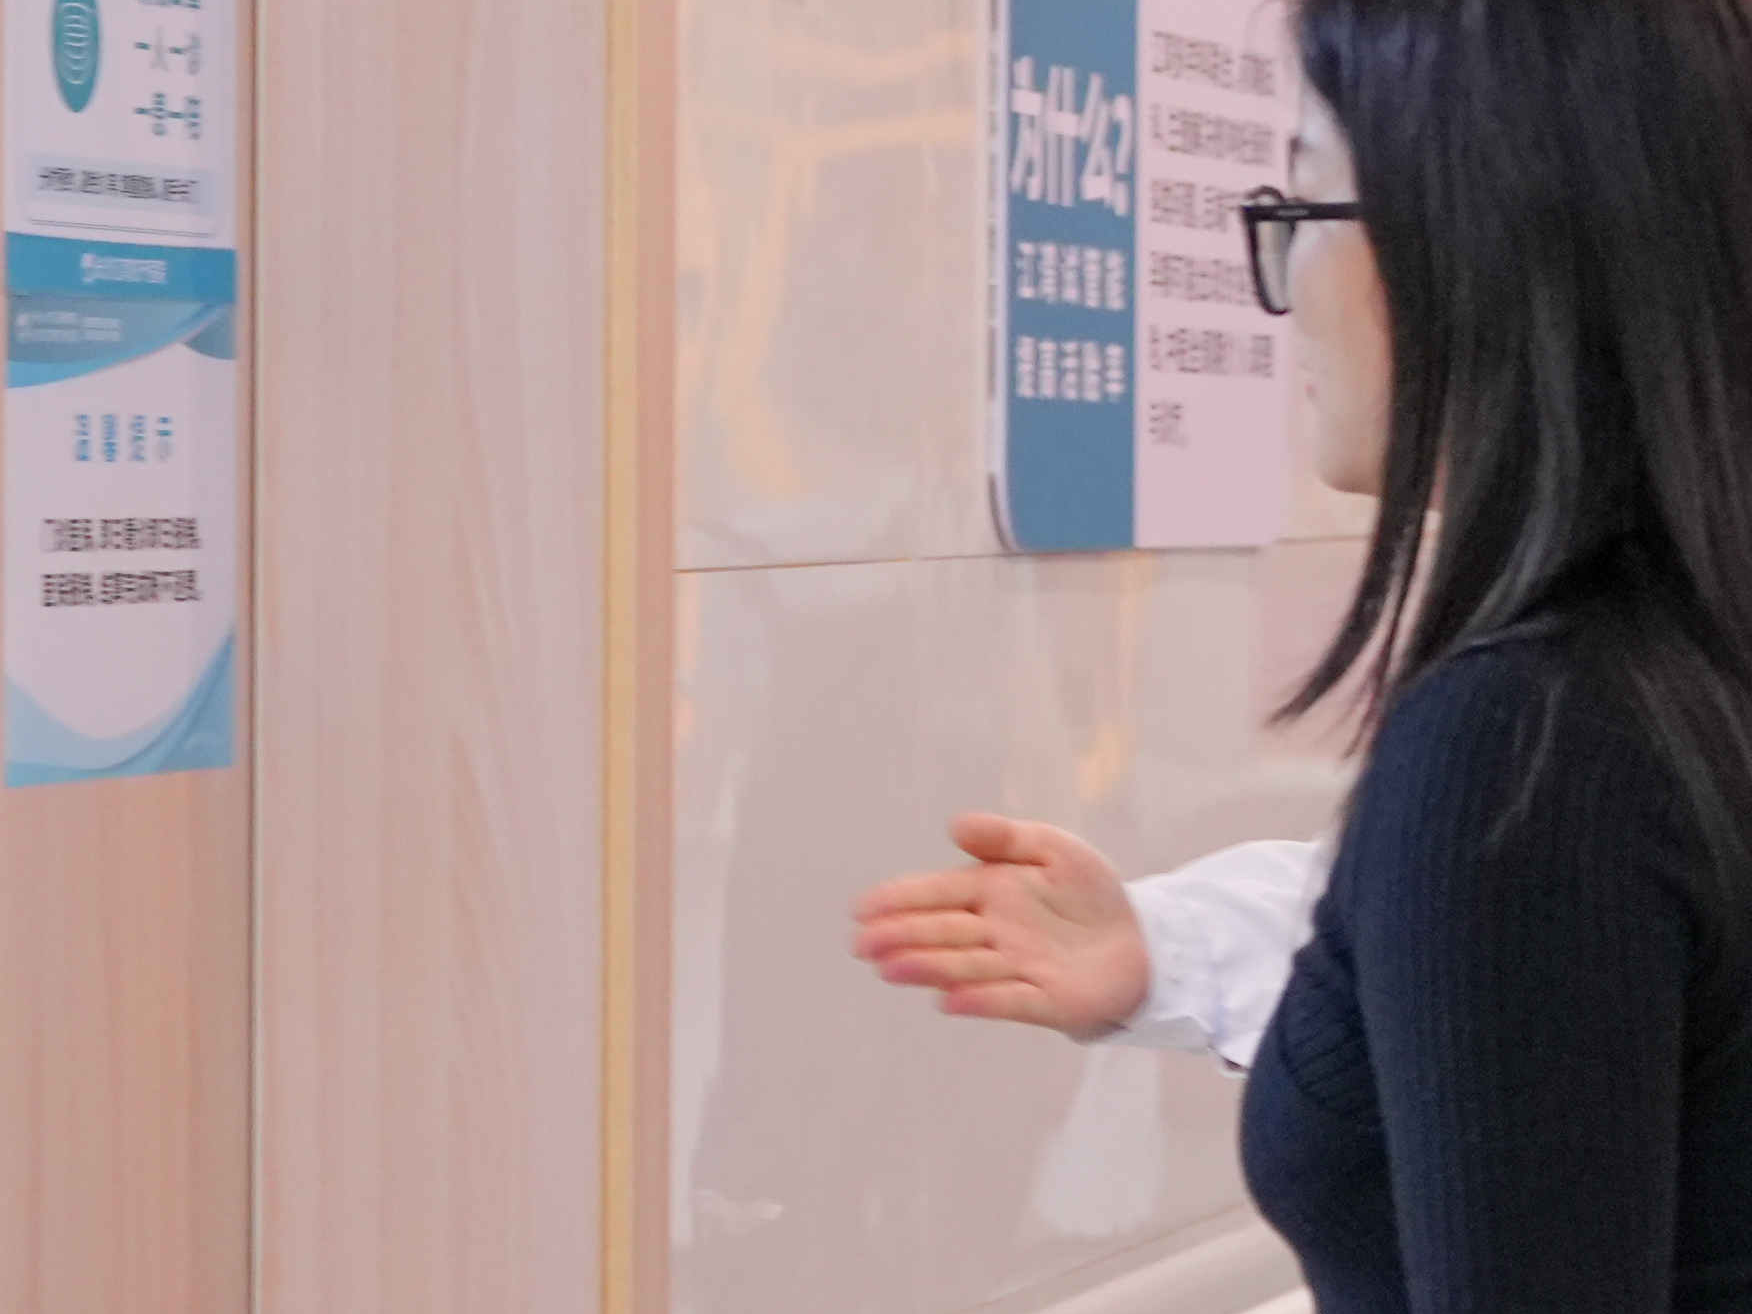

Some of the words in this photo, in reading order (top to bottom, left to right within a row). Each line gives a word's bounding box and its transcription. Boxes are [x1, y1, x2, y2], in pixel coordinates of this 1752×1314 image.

[1010, 55, 1134, 216] 为什么？
[73, 413, 174, 463] 温馨提示
